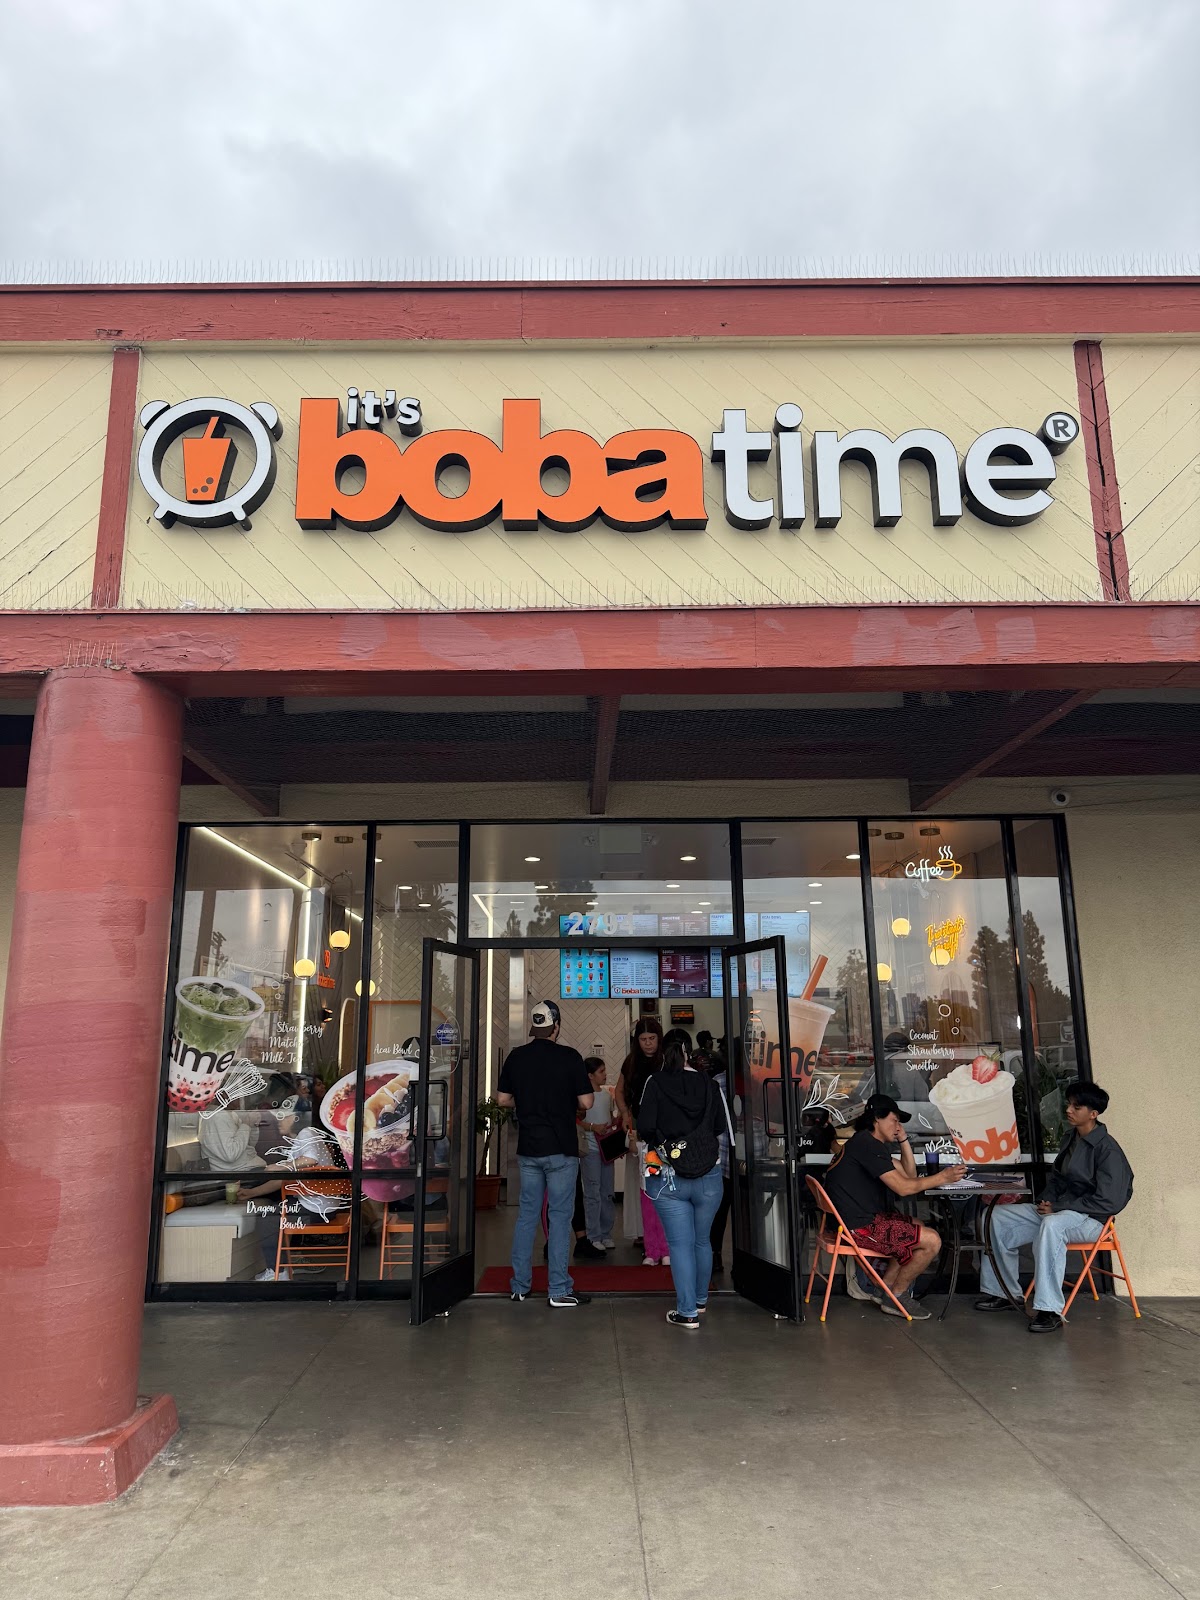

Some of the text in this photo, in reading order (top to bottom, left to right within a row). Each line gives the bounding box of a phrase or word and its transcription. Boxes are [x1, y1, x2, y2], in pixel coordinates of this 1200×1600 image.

[346, 387, 422, 427] it's
[905, 859, 944, 882] Coffee
[567, 911, 637, 936] 2794
[277, 1021, 323, 1038] Straberry
[909, 1028, 940, 1041] Coconut
[260, 1051, 285, 1064] Milk
[392, 1043, 413, 1055] Bowl
[907, 1043, 955, 1061] Strawberry
[905, 1058, 940, 1071] Smoothie
[246, 1199, 301, 1218] Dragon Fruit
